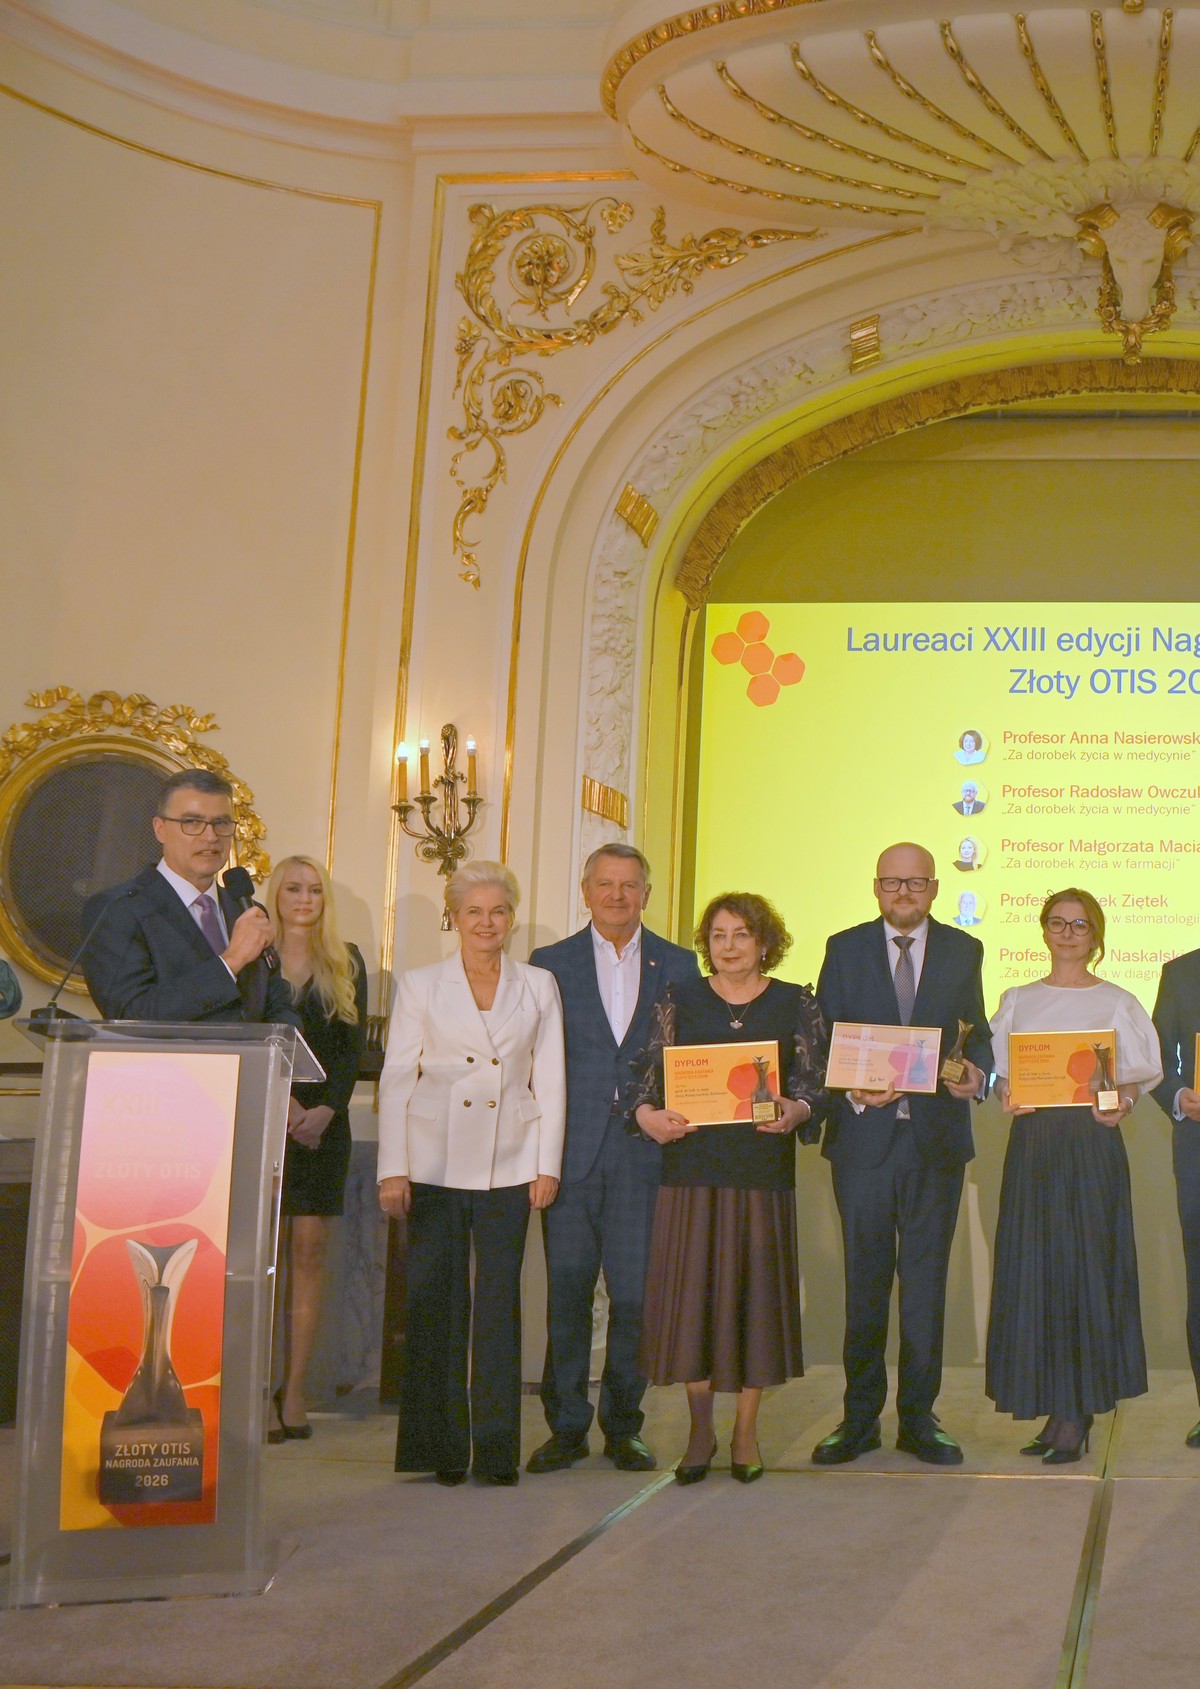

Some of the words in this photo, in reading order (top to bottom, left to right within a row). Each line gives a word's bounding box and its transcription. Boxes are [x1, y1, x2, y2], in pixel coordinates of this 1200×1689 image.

[847, 626, 974, 653] Laureaci
[983, 626, 1047, 653] XXIII
[1057, 626, 1142, 660] edycji
[1009, 668, 1081, 701] Złoty
[1090, 668, 1159, 696] OTIS
[1003, 731, 1066, 745] Profesor
[1070, 731, 1109, 745] Anna
[1027, 750, 1077, 761] dorobek
[1080, 750, 1109, 763] życia
[1113, 752, 1123, 760] w
[1002, 785, 1065, 799] Profesor
[1070, 785, 1144, 799] Radosław
[1025, 804, 1076, 815] dorobek
[1080, 804, 1109, 816] życia
[1113, 806, 1123, 815] w
[1001, 839, 1064, 853] Profesor
[1070, 839, 1153, 856] Małgorzata
[1025, 857, 1075, 869] dorobek
[1079, 858, 1108, 871] życia
[1113, 861, 1122, 869] w
[1001, 893, 1047, 907] Profes
[1122, 894, 1168, 909] Ziętek
[1112, 915, 1121, 924] w
[1000, 948, 1051, 961] Profes
[1023, 967, 1051, 978] doro
[1018, 1044, 1050, 1052] DYPLOM
[674, 1058, 709, 1068] DYPLOM
[160, 1162, 201, 1178] OTIS
[115, 1443, 157, 1457] ZŁOTY
[161, 1442, 191, 1455] OTIS
[105, 1459, 151, 1469] NAGRODA
[153, 1457, 199, 1467] ZAUFANIA
[135, 1474, 169, 1487] 2026
